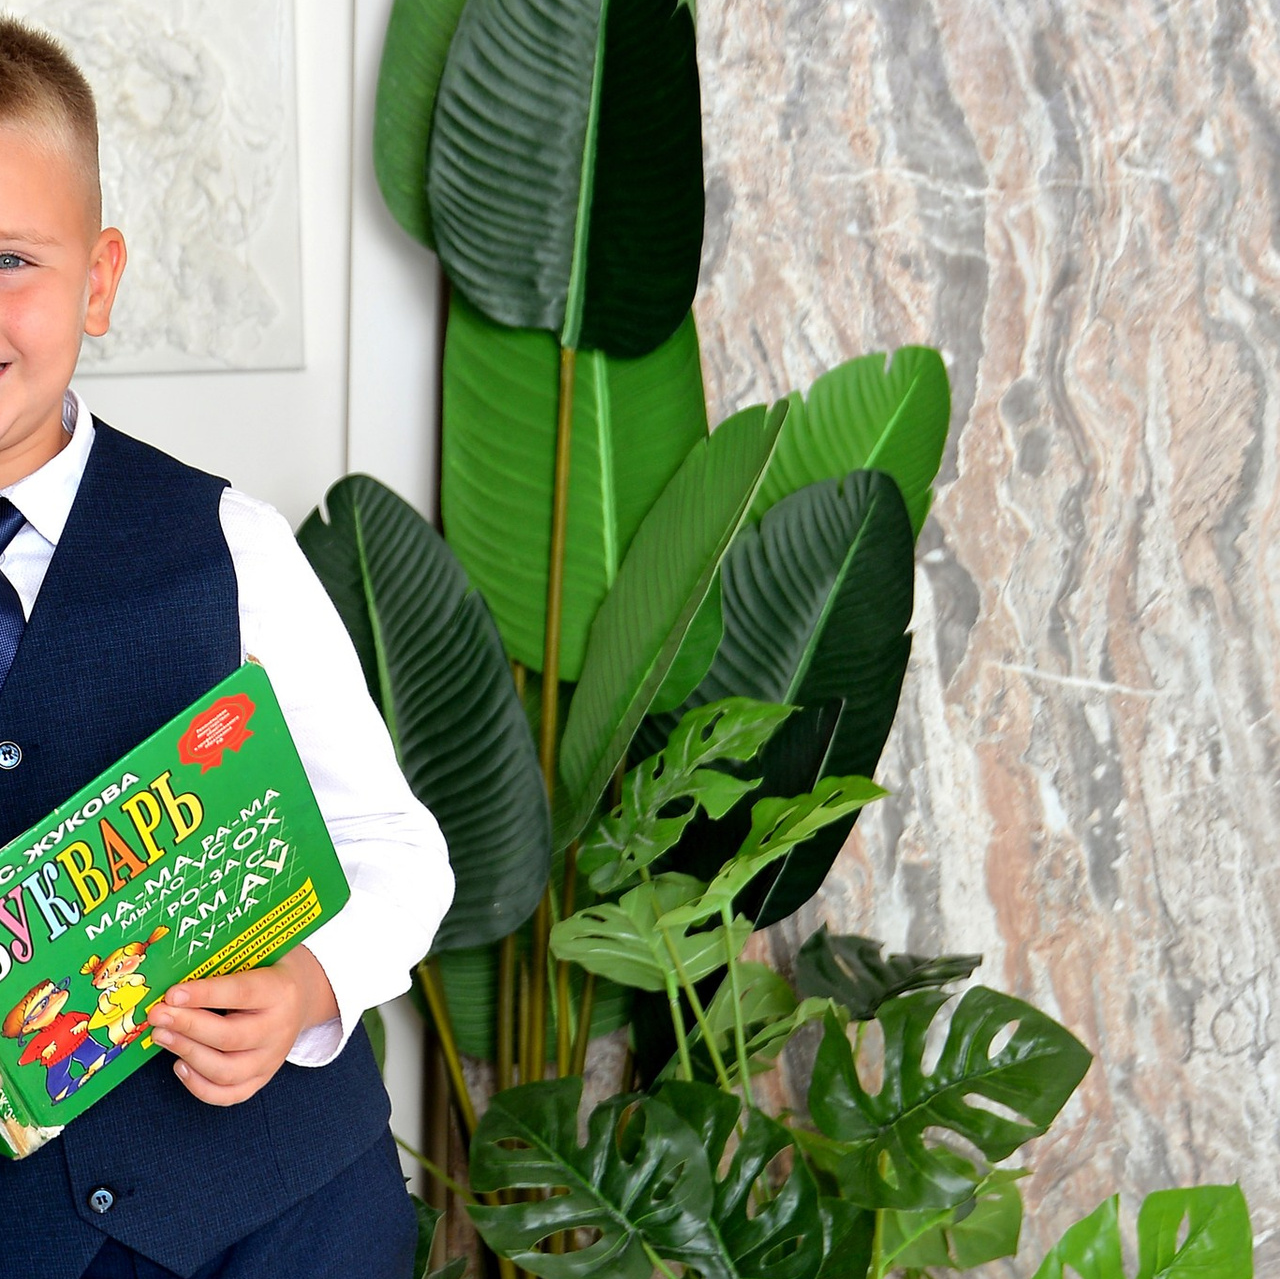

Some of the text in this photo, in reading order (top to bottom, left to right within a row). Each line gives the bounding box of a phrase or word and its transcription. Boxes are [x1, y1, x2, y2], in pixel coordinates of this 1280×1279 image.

[23, 772, 140, 865] ЖУКОВА
[217, 887, 308, 960] ТРАДИЦИОННОЙ
[223, 900, 312, 969] ОРИГИНАЛЬНОЙ
[256, 911, 316, 961] МЕТОДИКИ
